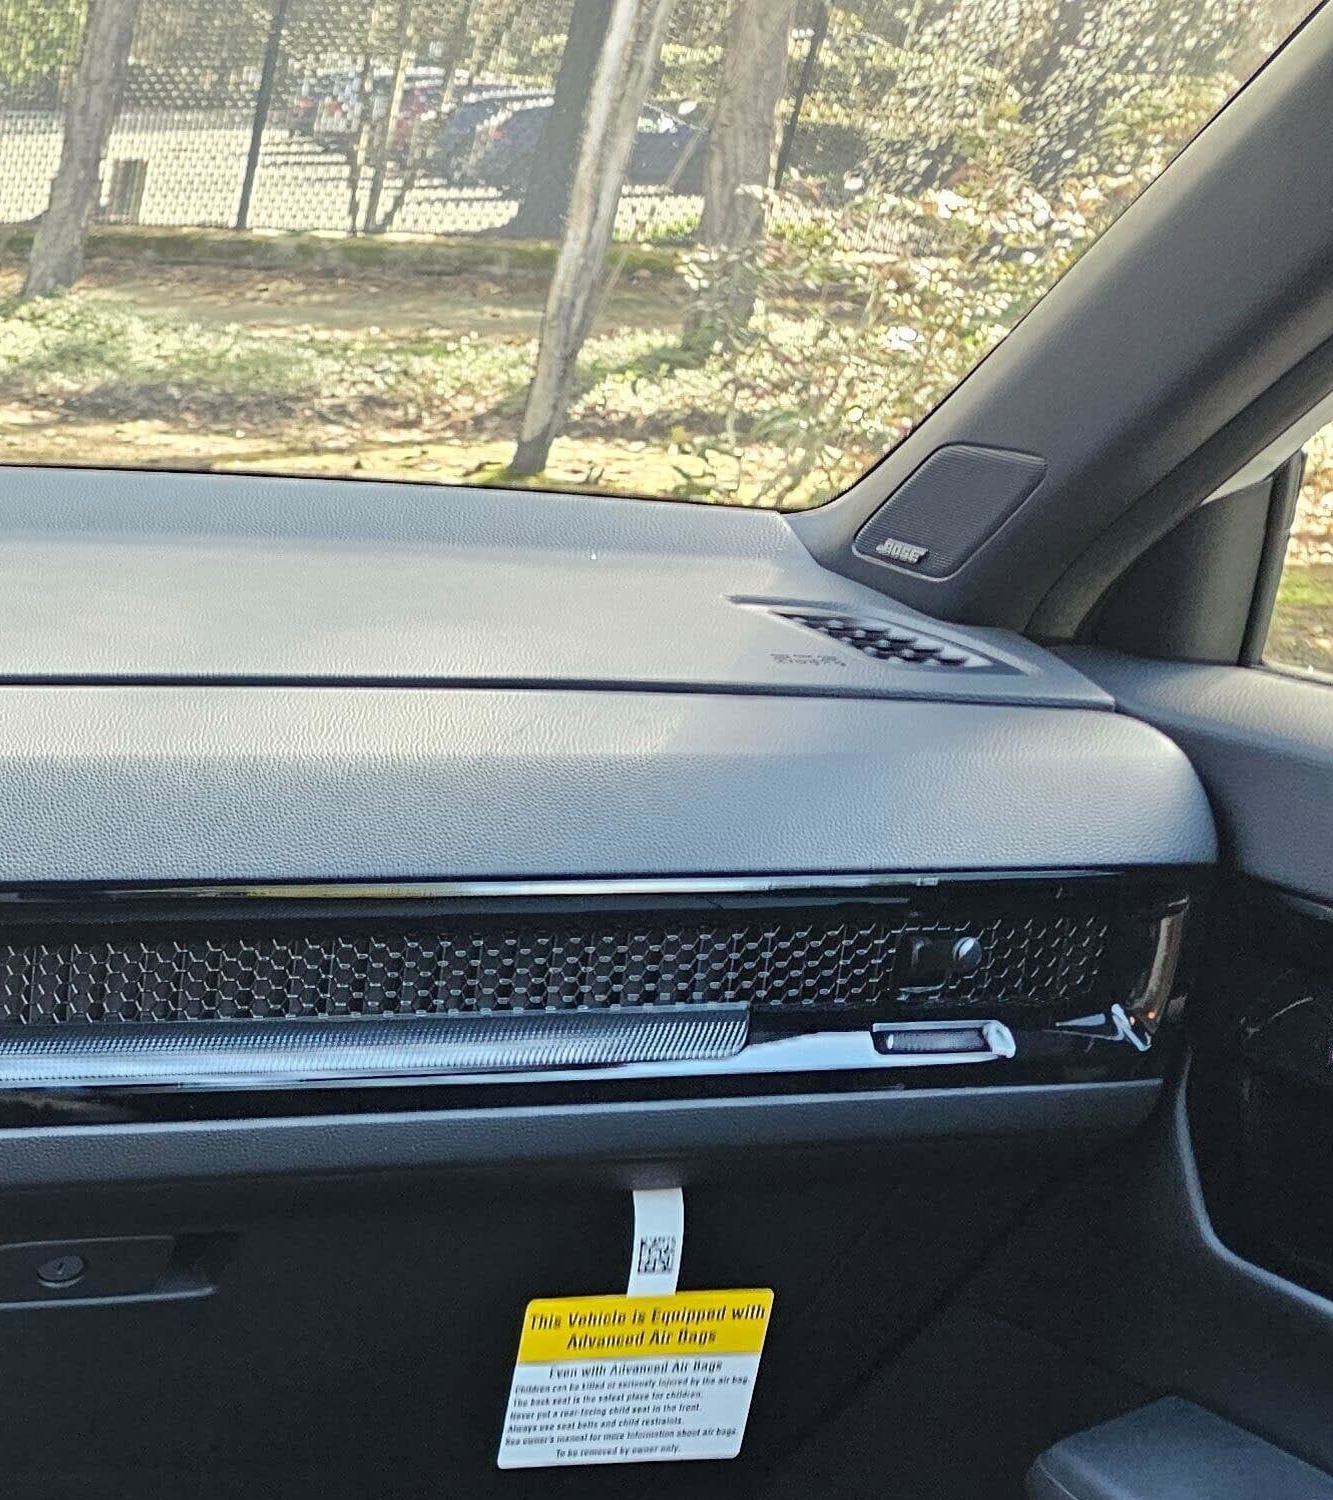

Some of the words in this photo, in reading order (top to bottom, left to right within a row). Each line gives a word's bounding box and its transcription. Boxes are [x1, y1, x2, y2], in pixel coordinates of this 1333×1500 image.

[531, 1314, 562, 1329] This
[569, 1309, 626, 1327] Vehicle
[632, 1309, 646, 1324] is
[652, 1305, 727, 1326] Equipped
[732, 1304, 765, 1320] with
[566, 1331, 645, 1350] Advanced
[649, 1329, 671, 1345] Air
[678, 1328, 716, 1345] Bags
[549, 1365, 577, 1378] Even
[581, 1364, 606, 1377] with
[610, 1361, 668, 1376] Advanced
[672, 1360, 689, 1373] Air
[694, 1360, 722, 1373] Bags
